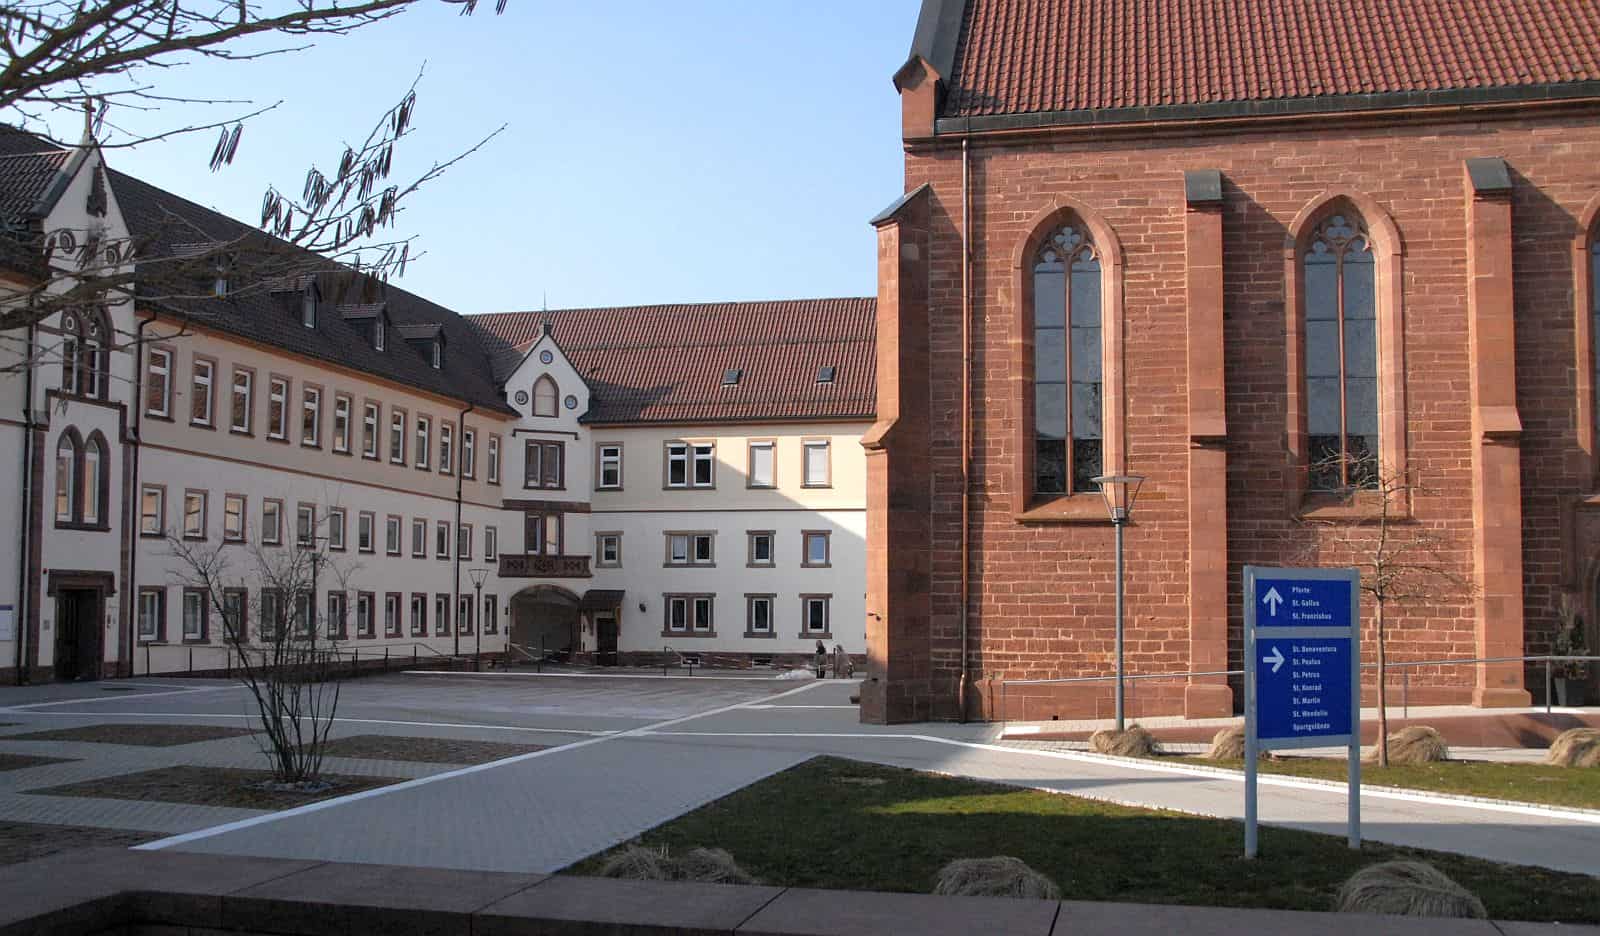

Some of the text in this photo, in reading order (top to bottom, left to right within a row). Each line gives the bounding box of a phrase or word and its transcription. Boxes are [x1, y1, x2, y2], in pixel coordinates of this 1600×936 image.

[1292, 599, 1320, 607] St. Gallus
[1292, 612, 1300, 620] St.
[1292, 645, 1300, 653] St.
[1292, 671, 1300, 679] St.
[1292, 683, 1322, 692] St. Konrad
[1302, 696, 1320, 704] Martin
[1292, 710, 1301, 718] St.
